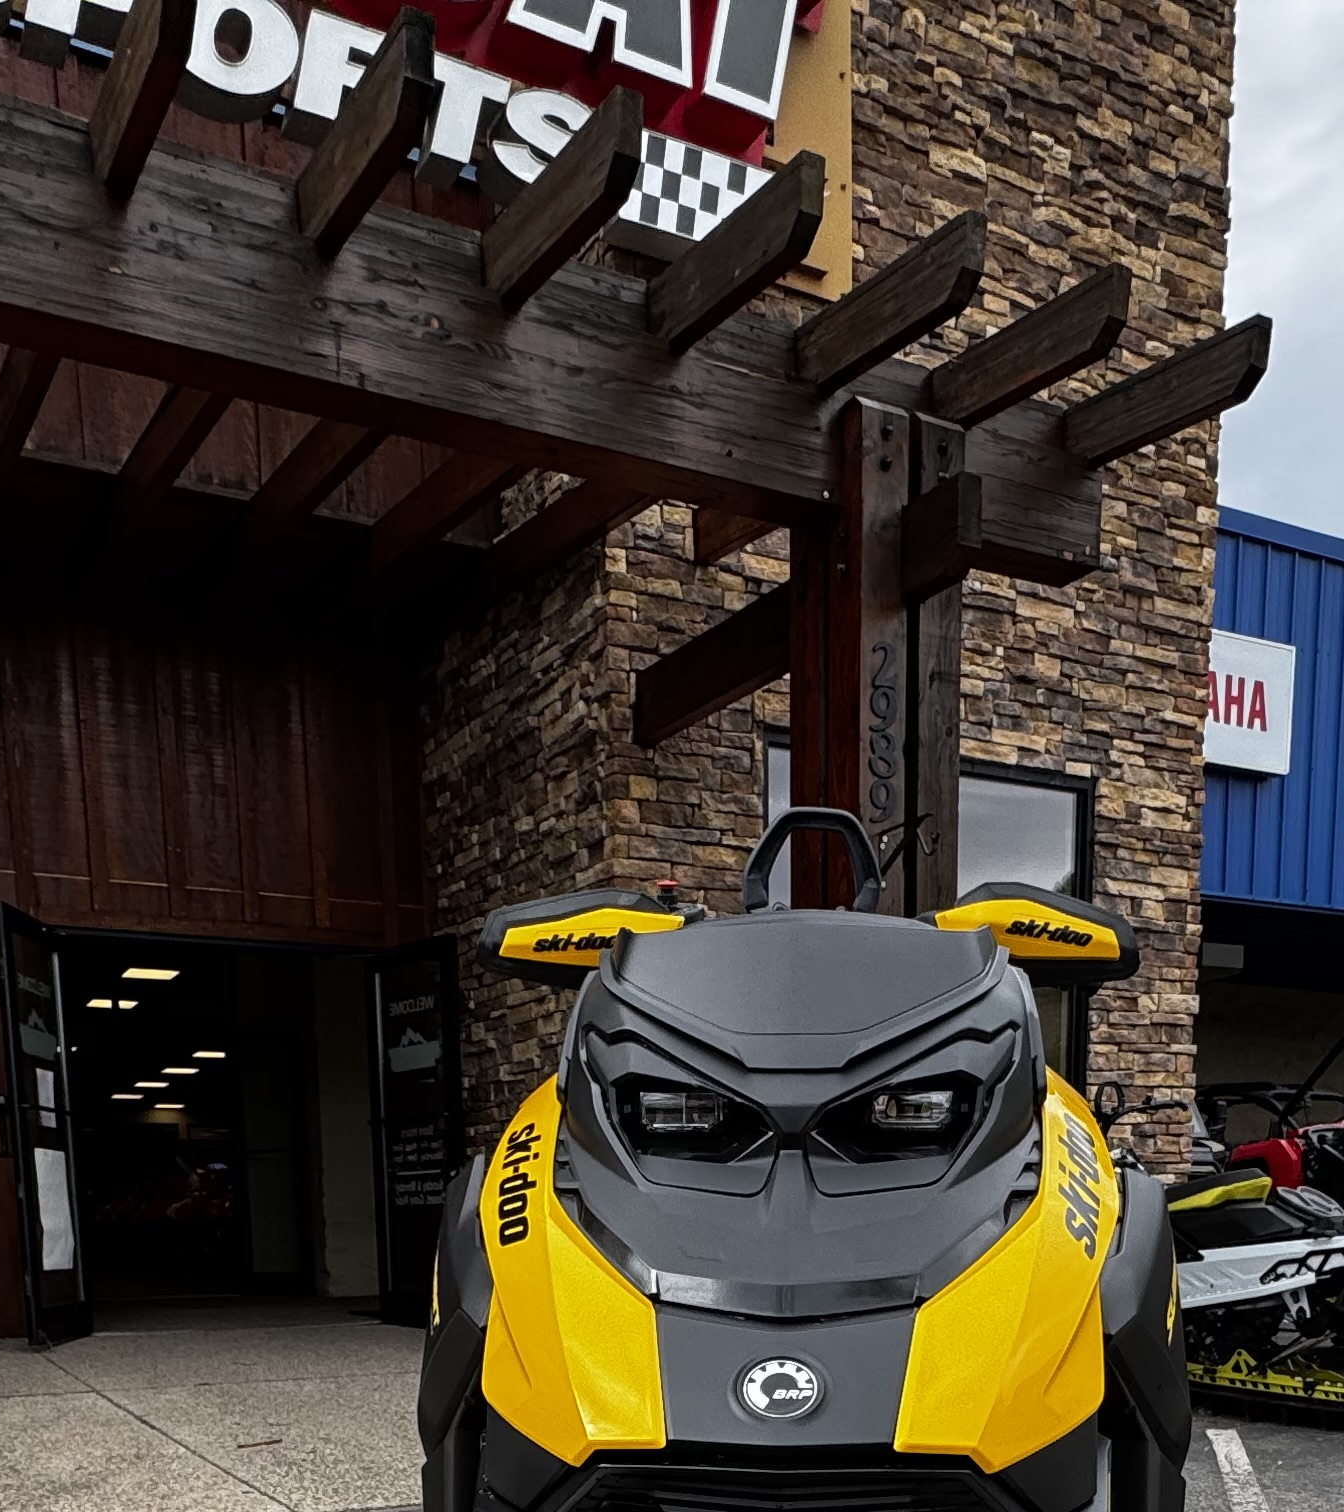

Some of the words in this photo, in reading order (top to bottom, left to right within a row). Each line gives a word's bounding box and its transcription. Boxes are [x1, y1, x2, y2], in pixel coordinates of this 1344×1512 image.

[869, 641, 898, 824] 2989
[1005, 920, 1094, 947] ski-doo
[498, 1122, 542, 1247] ski-doo
[1058, 1113, 1101, 1261] ski-doo
[772, 1389, 813, 1400] BRP
